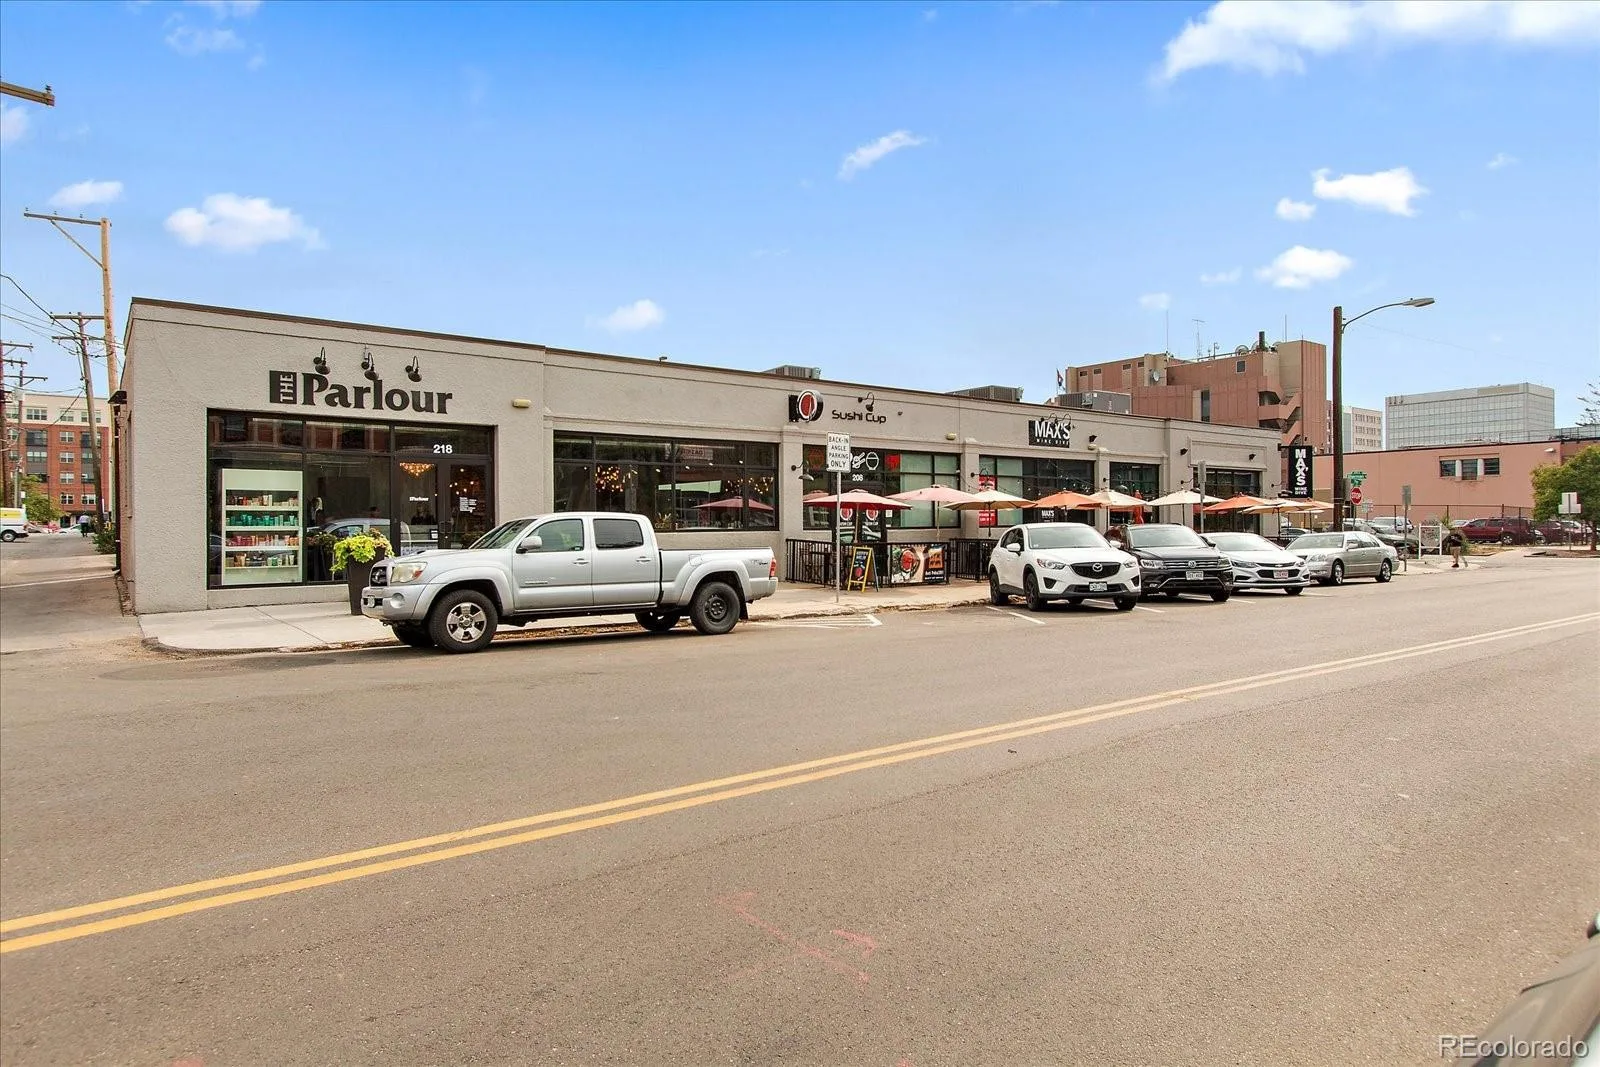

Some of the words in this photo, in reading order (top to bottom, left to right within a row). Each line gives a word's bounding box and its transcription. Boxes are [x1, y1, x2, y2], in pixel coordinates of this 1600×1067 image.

[280, 374, 294, 402] THE
[302, 372, 453, 414] Parlour
[832, 409, 863, 421] Sushi
[865, 412, 887, 424] Cup
[1035, 420, 1070, 440] MAX'S
[433, 444, 453, 454] 218
[830, 460, 847, 468] ONLY
